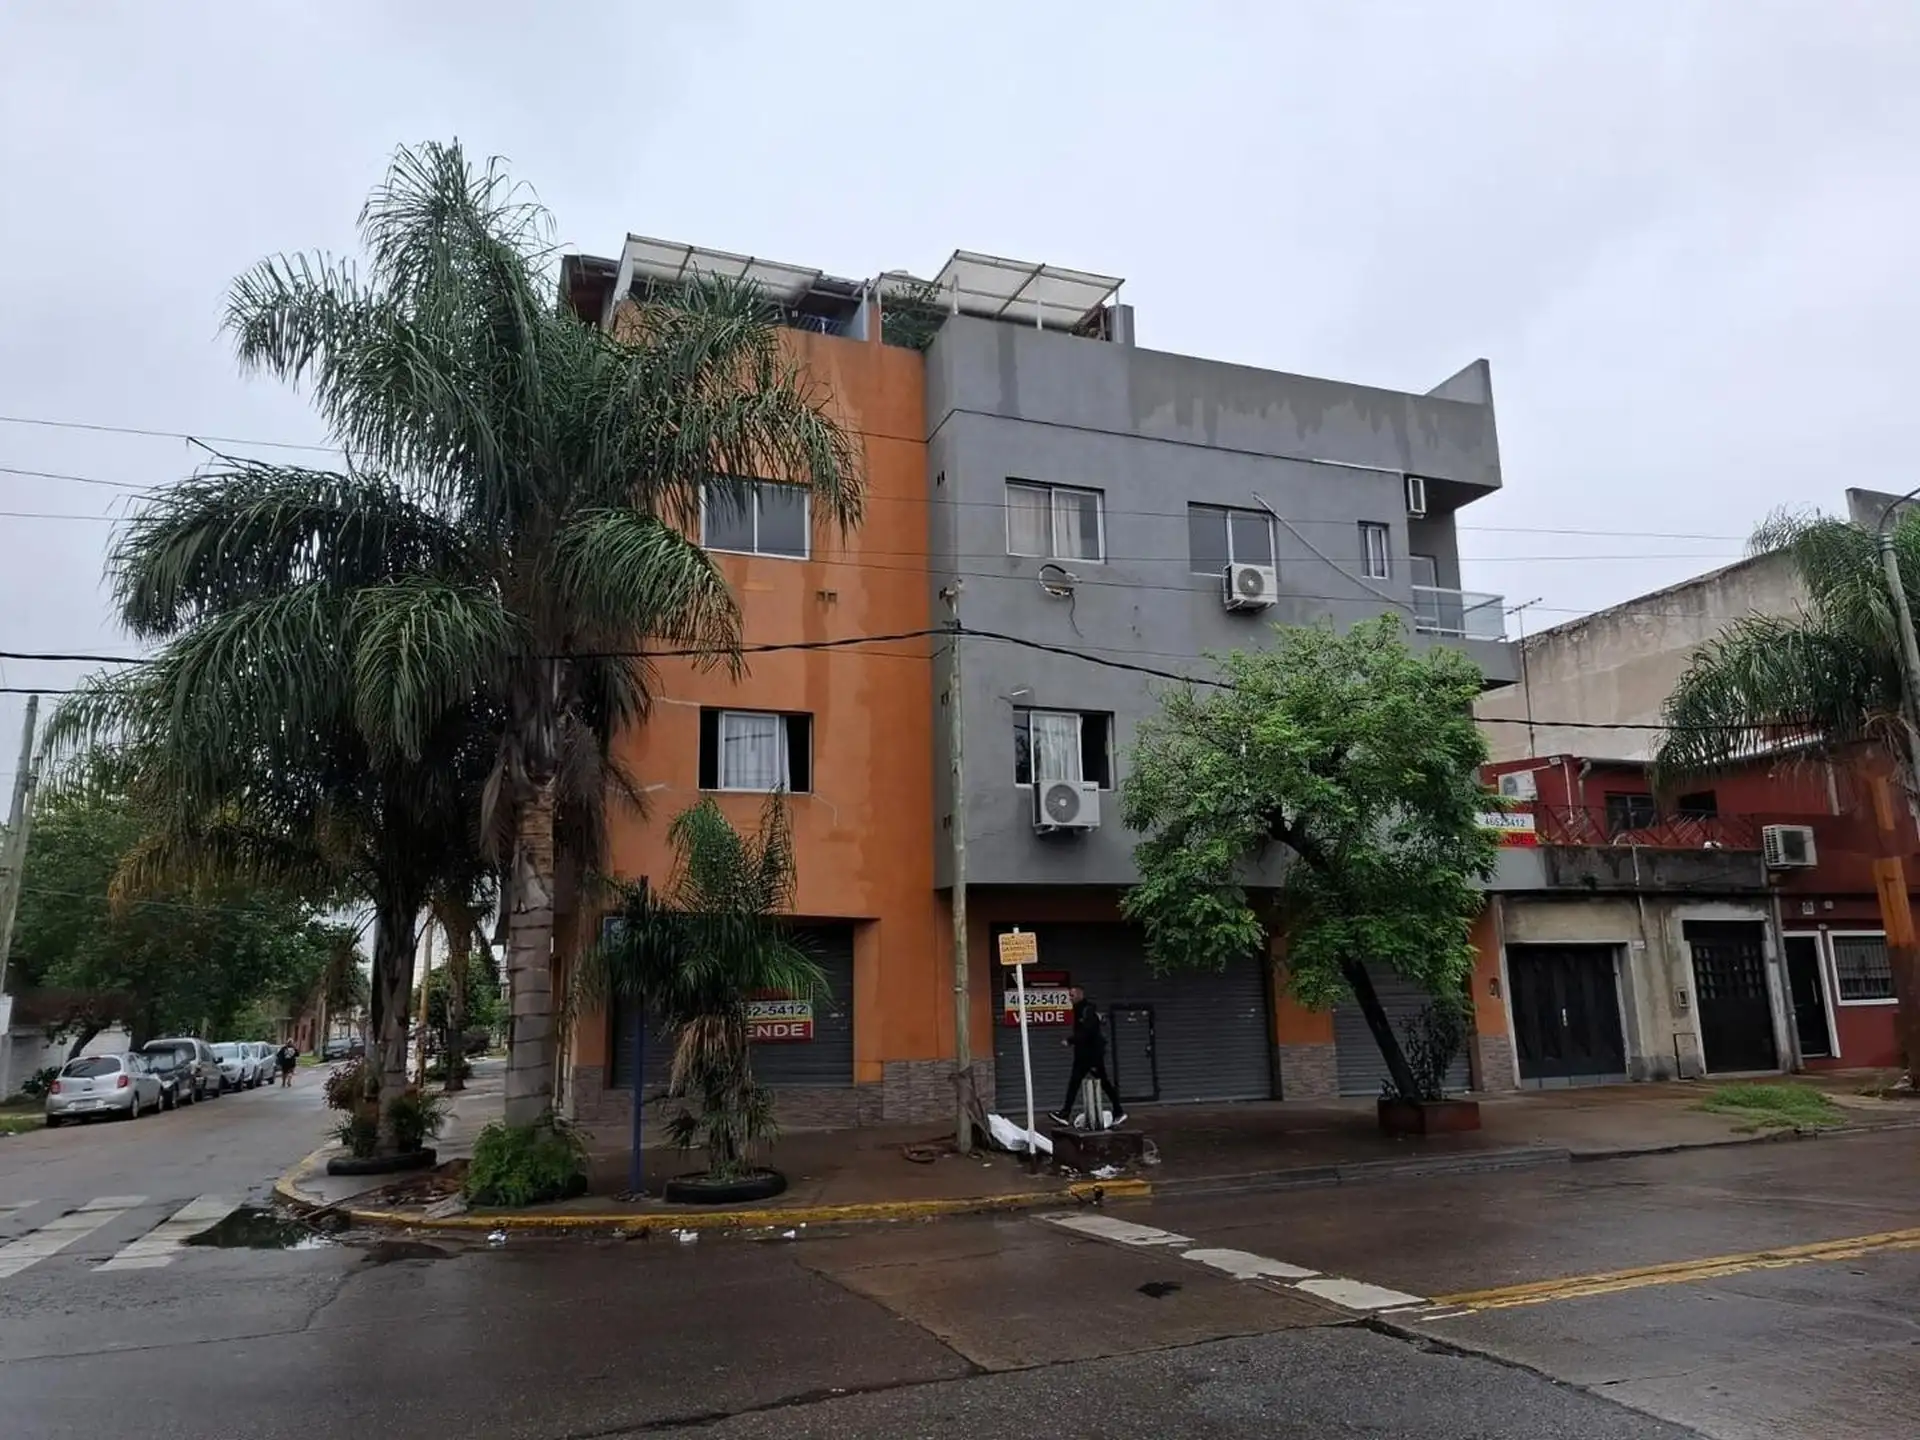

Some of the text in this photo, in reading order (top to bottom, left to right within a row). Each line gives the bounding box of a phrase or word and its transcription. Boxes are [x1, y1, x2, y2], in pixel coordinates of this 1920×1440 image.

[1009, 993, 1068, 1005] 452-5412
[1012, 1010, 1065, 1023] VENDE
[746, 1023, 805, 1037] ENDE
